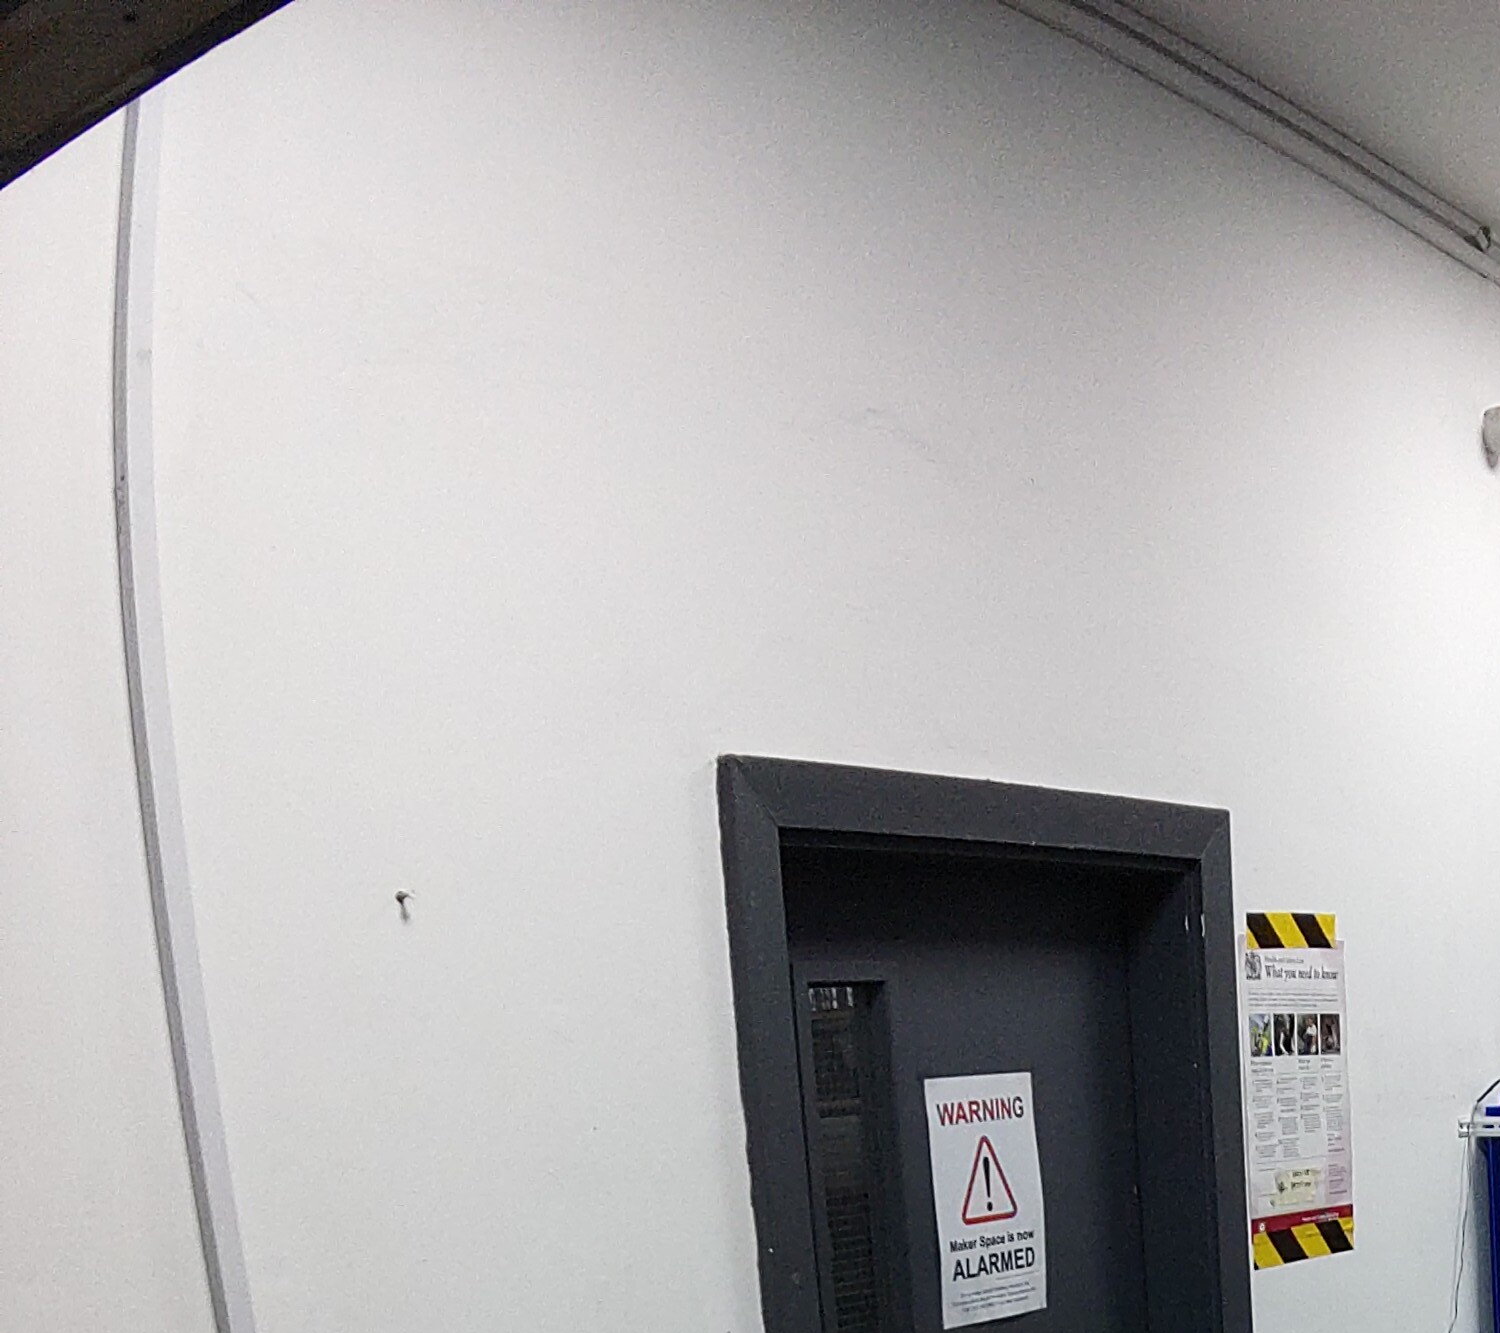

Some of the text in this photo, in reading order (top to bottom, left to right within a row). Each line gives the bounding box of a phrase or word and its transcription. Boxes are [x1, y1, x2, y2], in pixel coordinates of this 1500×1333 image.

[1265, 964, 1283, 978] What
[1284, 969, 1296, 982] you
[1298, 965, 1312, 979] need
[1313, 967, 1320, 979] to
[1321, 965, 1338, 979] know
[937, 1096, 1024, 1127] WARNING
[949, 1230, 1034, 1253] Maker Space is now
[953, 1246, 1035, 1281] ALARMED
